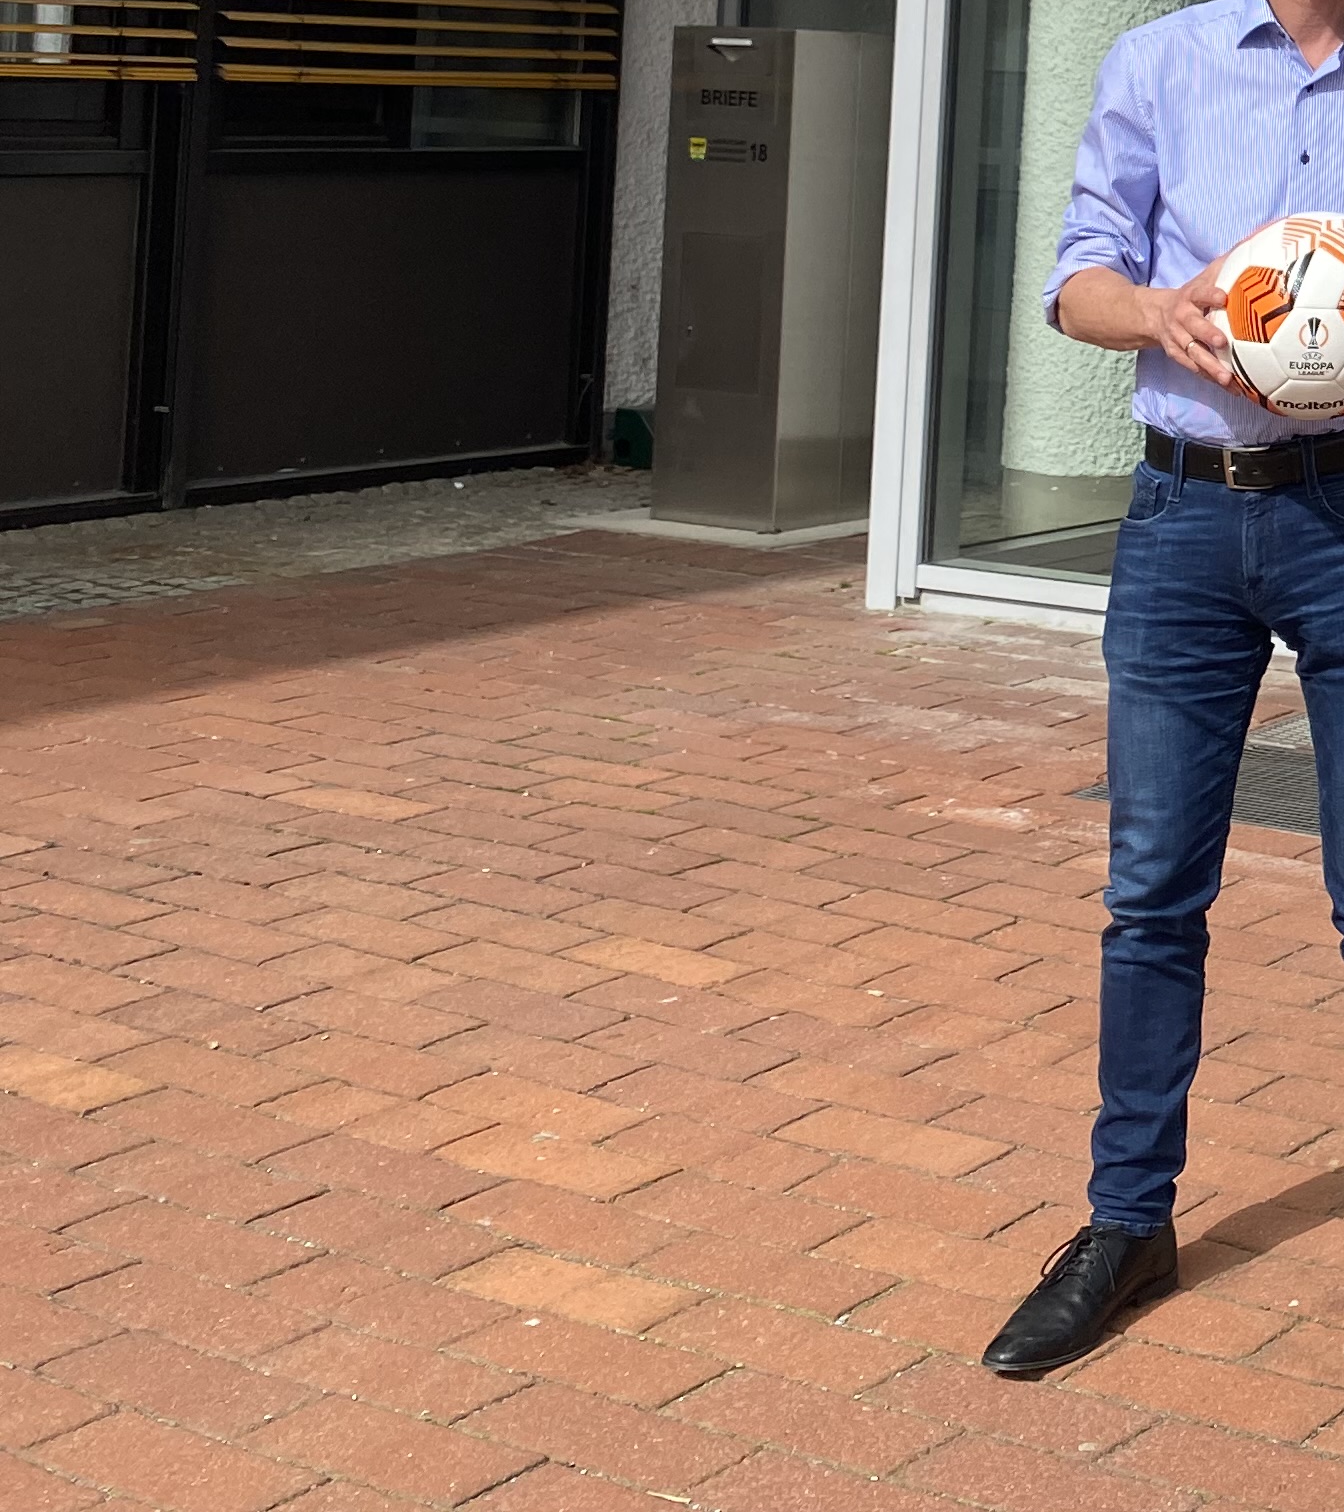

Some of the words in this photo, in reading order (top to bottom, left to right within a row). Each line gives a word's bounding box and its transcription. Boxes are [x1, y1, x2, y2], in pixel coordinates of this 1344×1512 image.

[700, 89, 758, 108] BRIEFE
[750, 143, 768, 162] 18
[1289, 361, 1334, 370] EUROPA
[1275, 399, 1344, 410] molten
